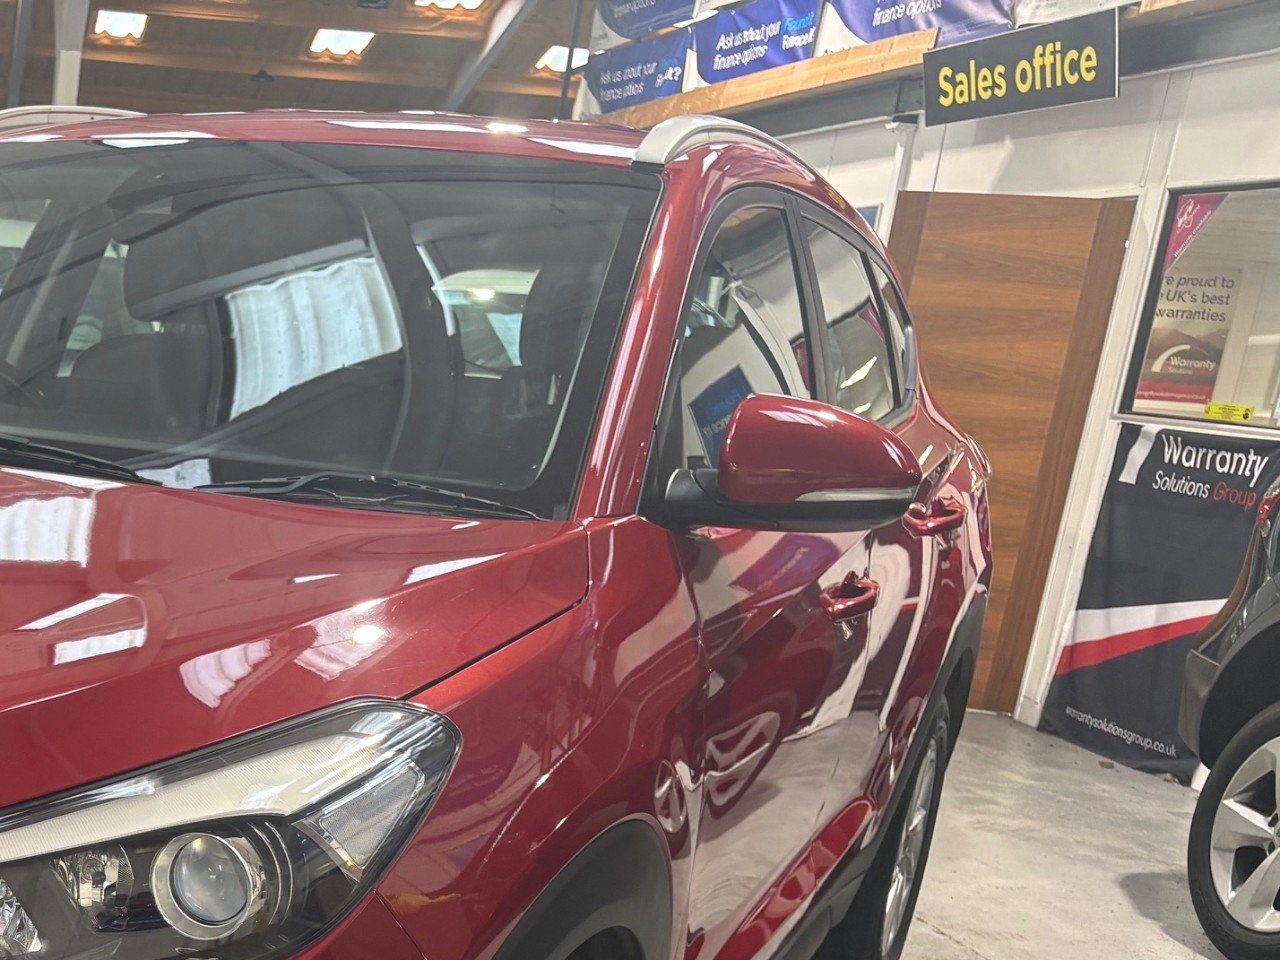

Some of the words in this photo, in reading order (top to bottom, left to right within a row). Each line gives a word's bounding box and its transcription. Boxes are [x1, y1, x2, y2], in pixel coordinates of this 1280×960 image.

[938, 59, 1007, 107] Sales
[1014, 40, 1098, 94] office
[1176, 275, 1218, 290] proud
[1221, 277, 1235, 289] to
[1166, 289, 1198, 303] UK's
[1201, 291, 1231, 306] best
[1170, 356, 1217, 371] Warranty
[1162, 434, 1269, 488] Warranty
[1152, 470, 1210, 498] Solutions
[1212, 481, 1257, 512] Group
